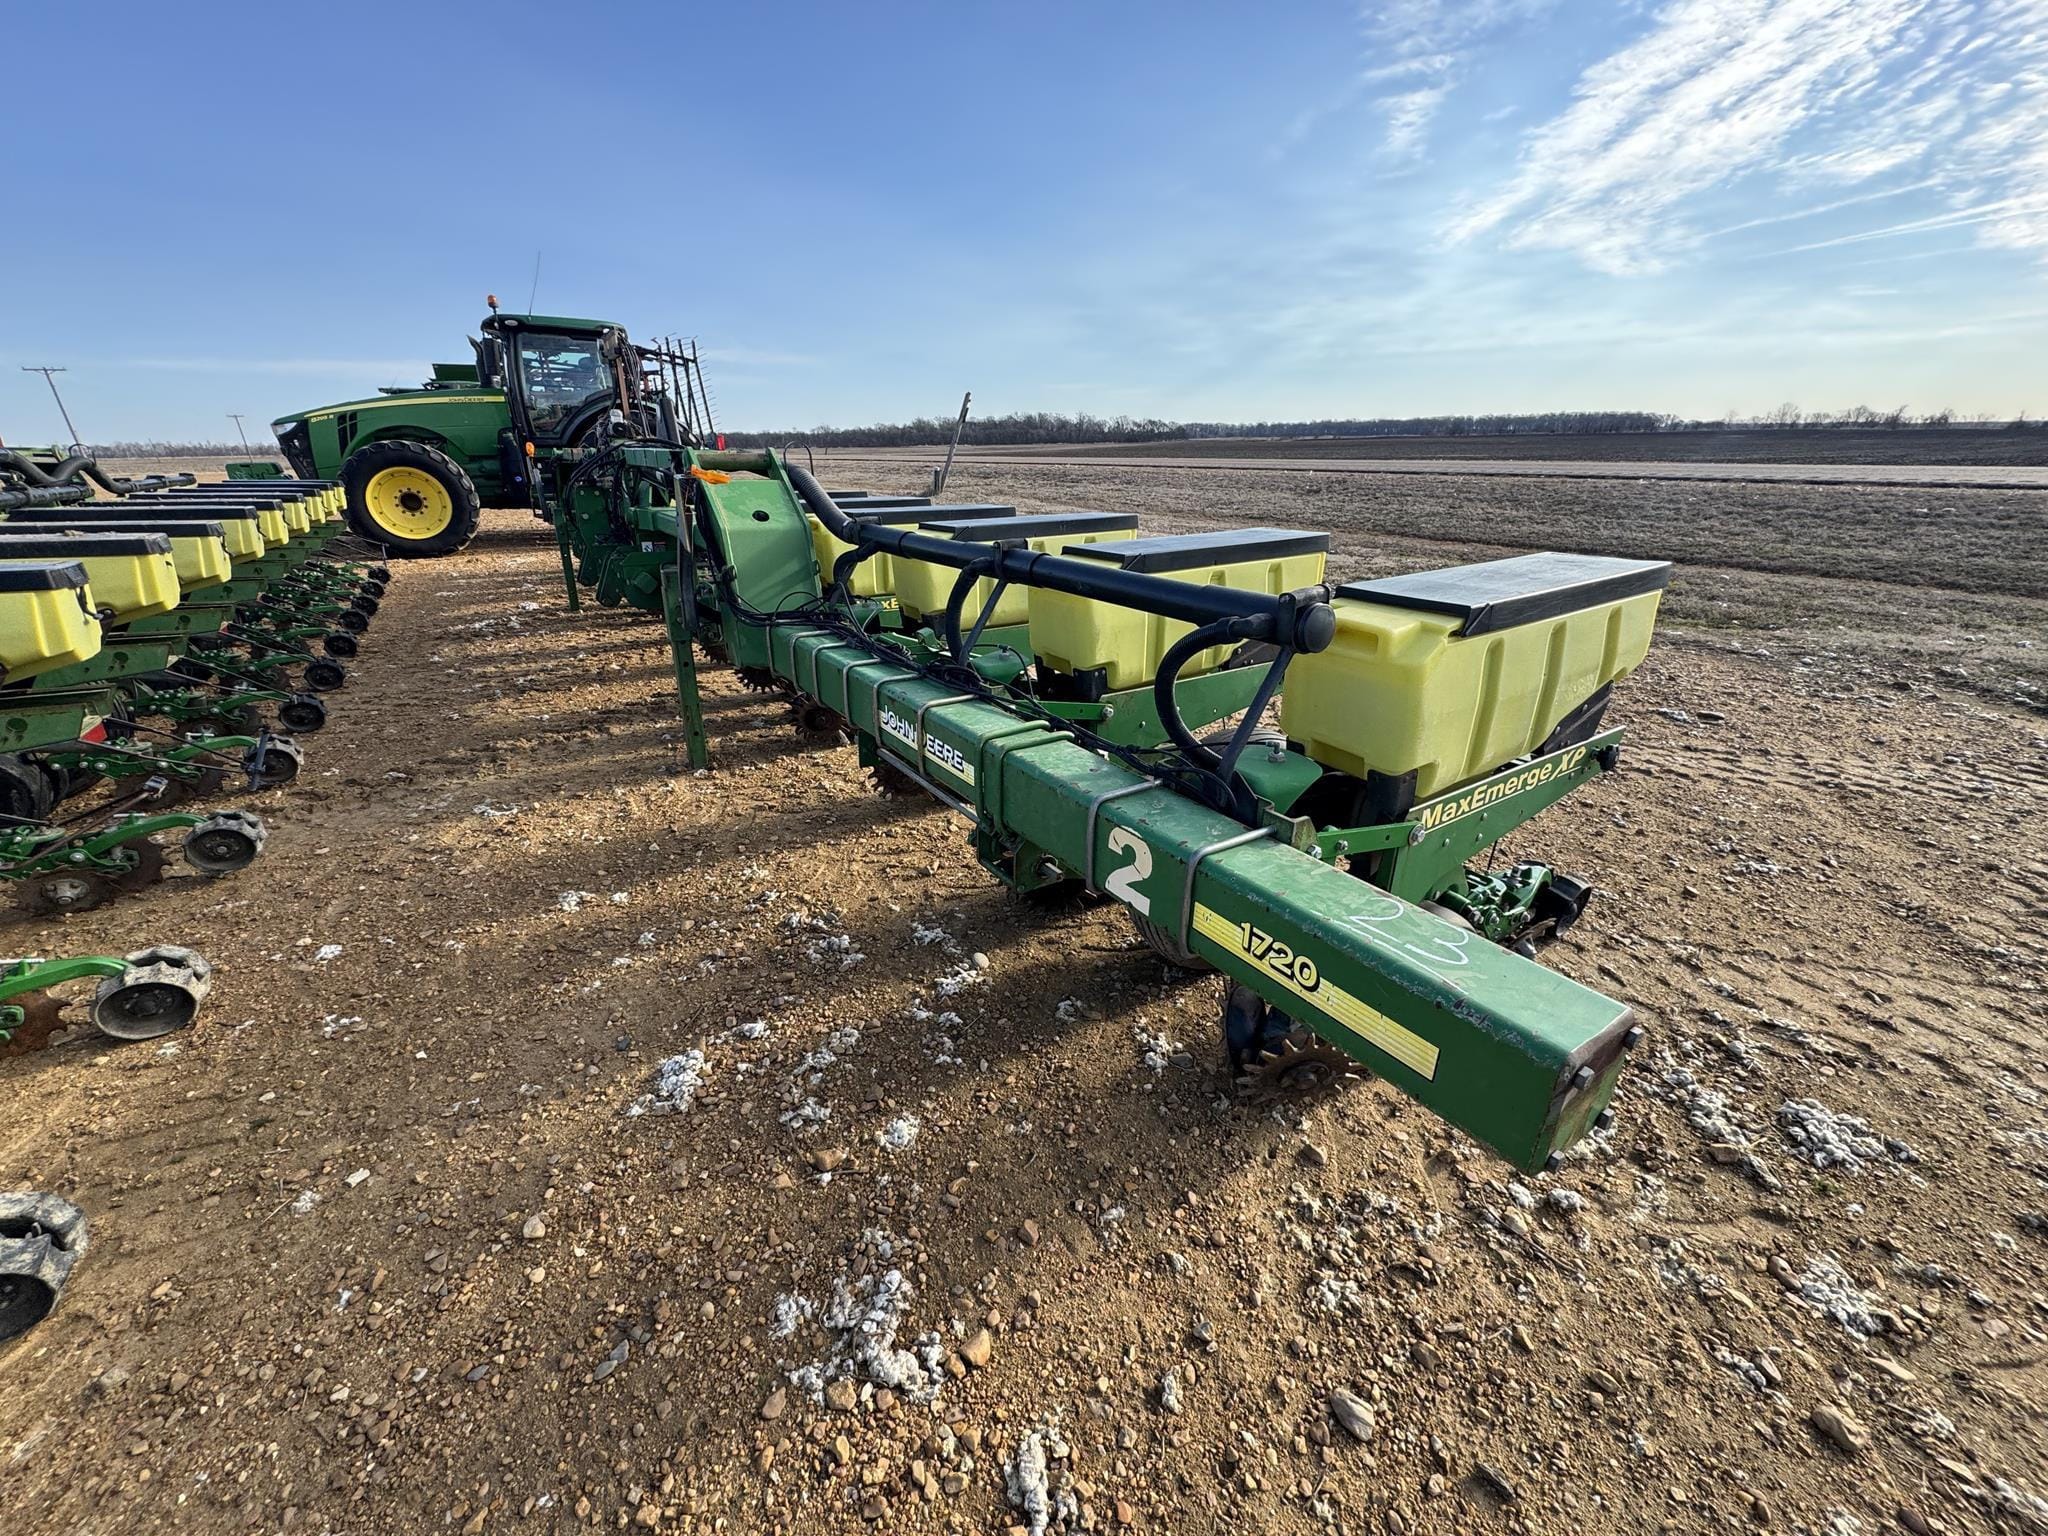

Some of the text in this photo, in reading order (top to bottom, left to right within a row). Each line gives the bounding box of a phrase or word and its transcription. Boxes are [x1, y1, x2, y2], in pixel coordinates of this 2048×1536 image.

[883, 705, 914, 741] JOHN
[1421, 746, 1586, 829] MaxEmerge XP
[1105, 826, 1153, 916] 2
[1241, 922, 1319, 990] 1720
[1347, 898, 1469, 965] 23
